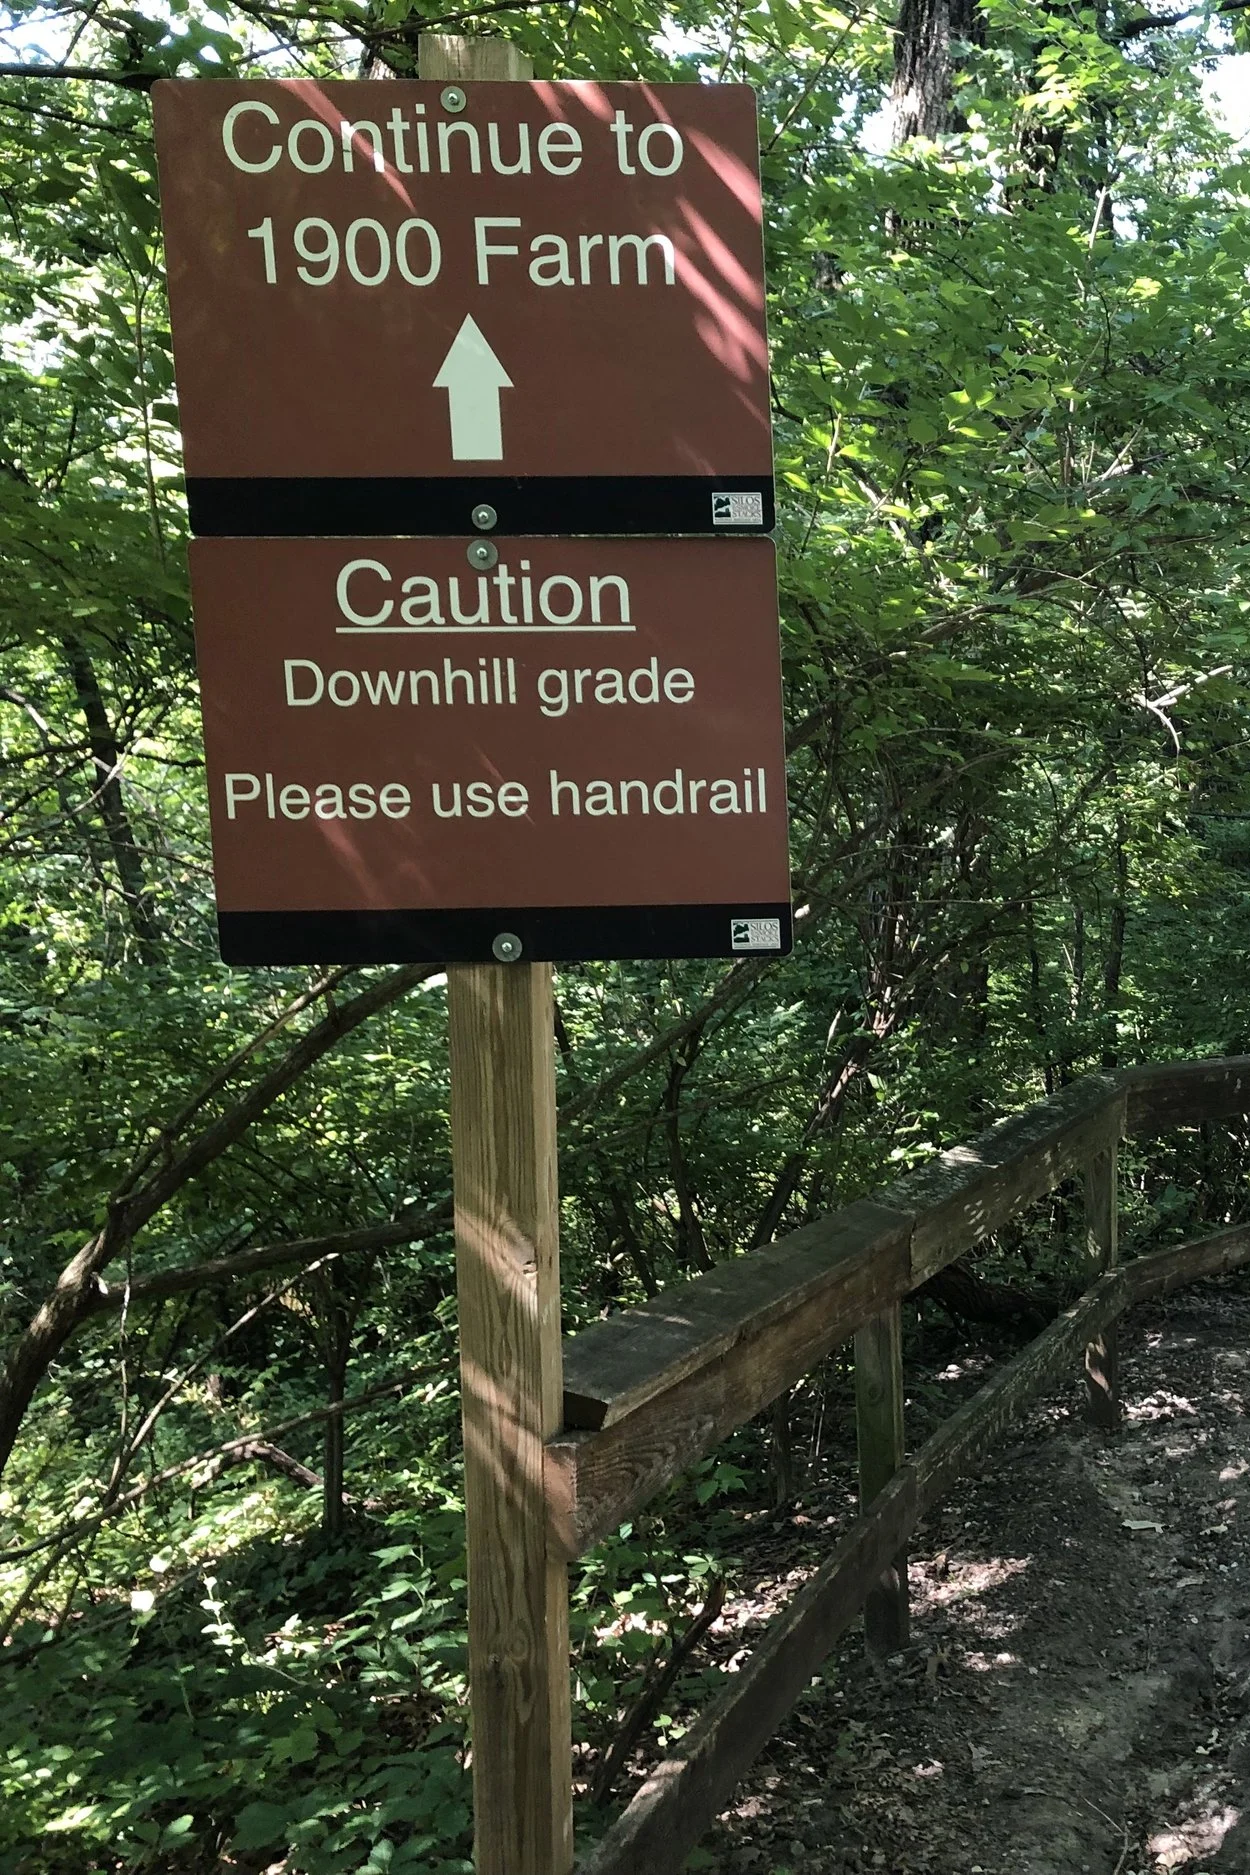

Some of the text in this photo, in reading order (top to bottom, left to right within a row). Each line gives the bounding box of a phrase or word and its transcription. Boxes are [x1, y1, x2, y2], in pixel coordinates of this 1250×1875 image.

[222, 100, 684, 177] Continue to
[247, 216, 676, 287] 1900 Farm
[335, 558, 632, 626] Caution
[283, 656, 695, 717] Downhill grade
[224, 767, 767, 820] Please use handrail
